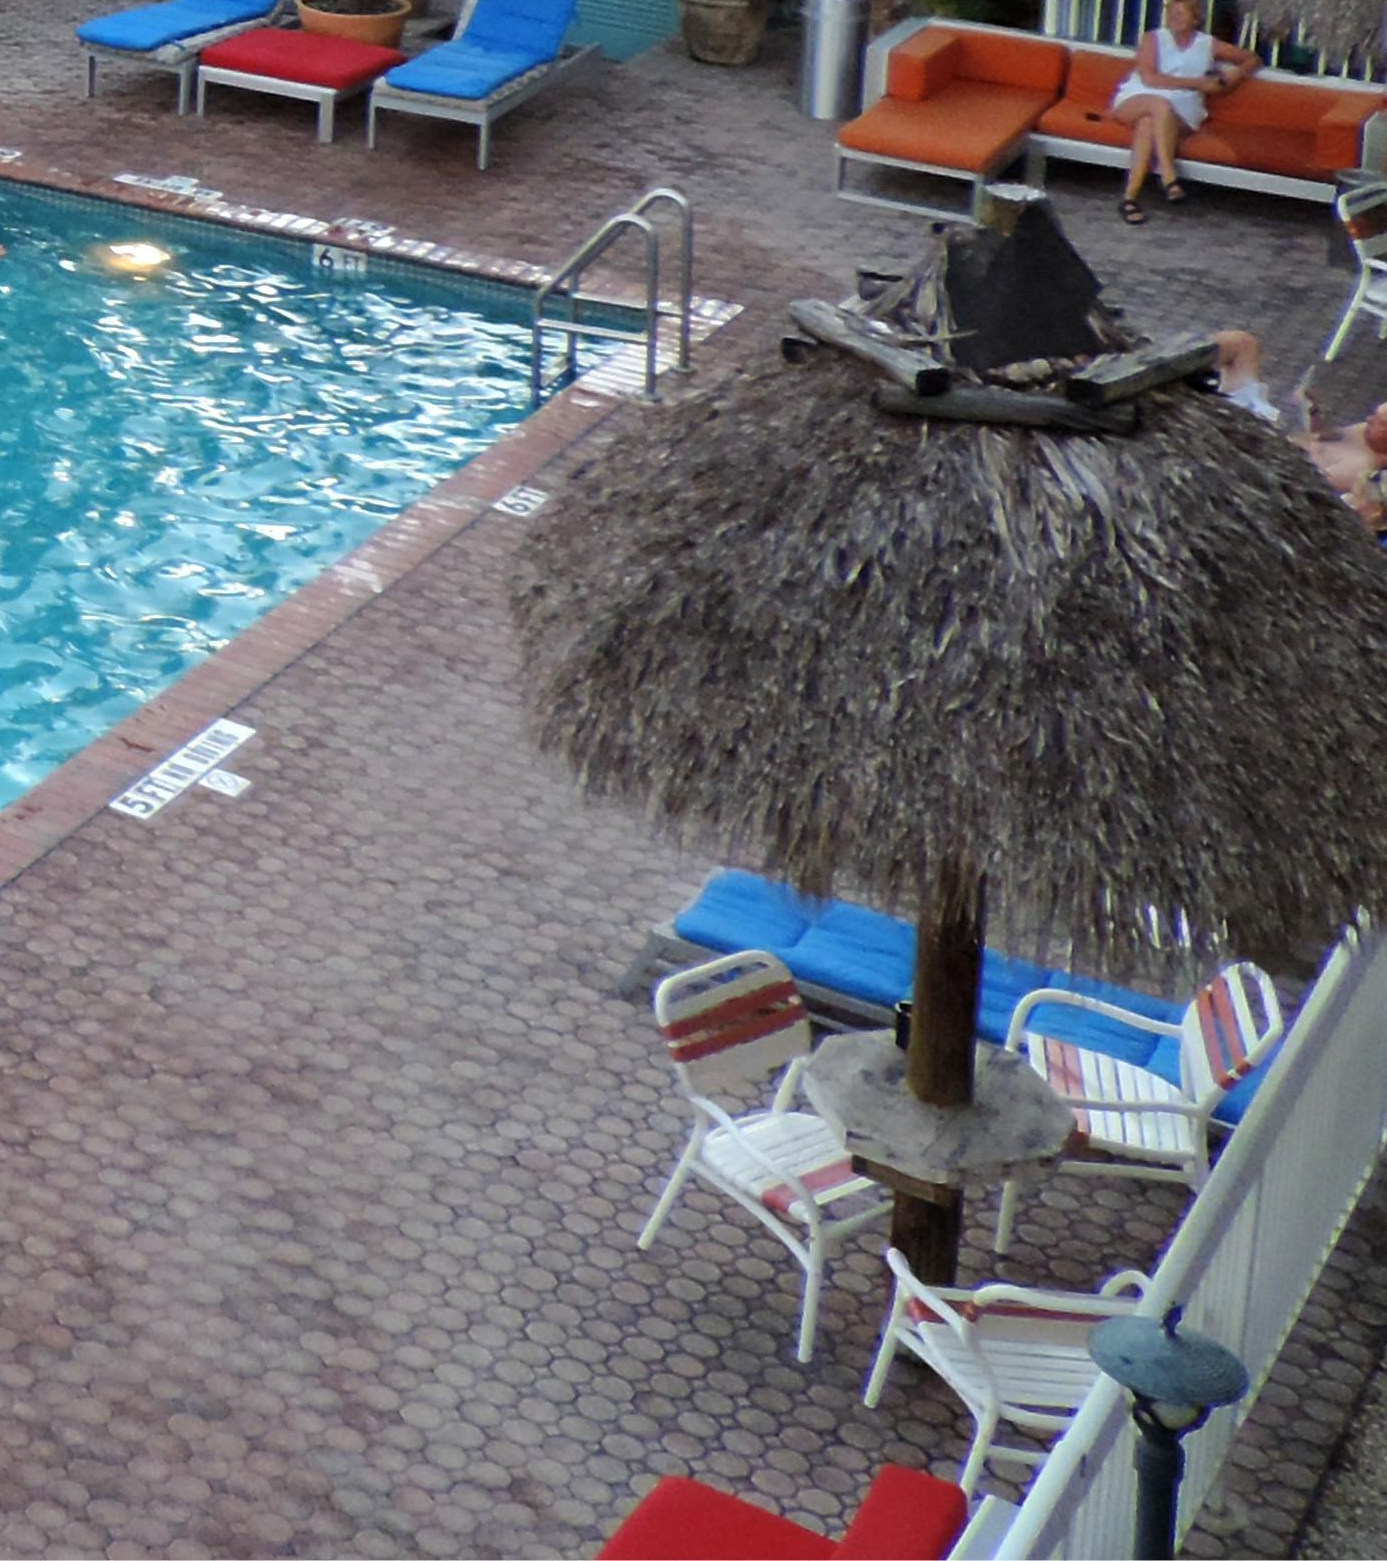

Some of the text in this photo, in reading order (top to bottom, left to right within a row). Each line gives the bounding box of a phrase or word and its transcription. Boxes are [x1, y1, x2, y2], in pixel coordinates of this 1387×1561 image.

[319, 248, 334, 270] 6
[118, 796, 154, 815] 5
[137, 777, 175, 803] FT
